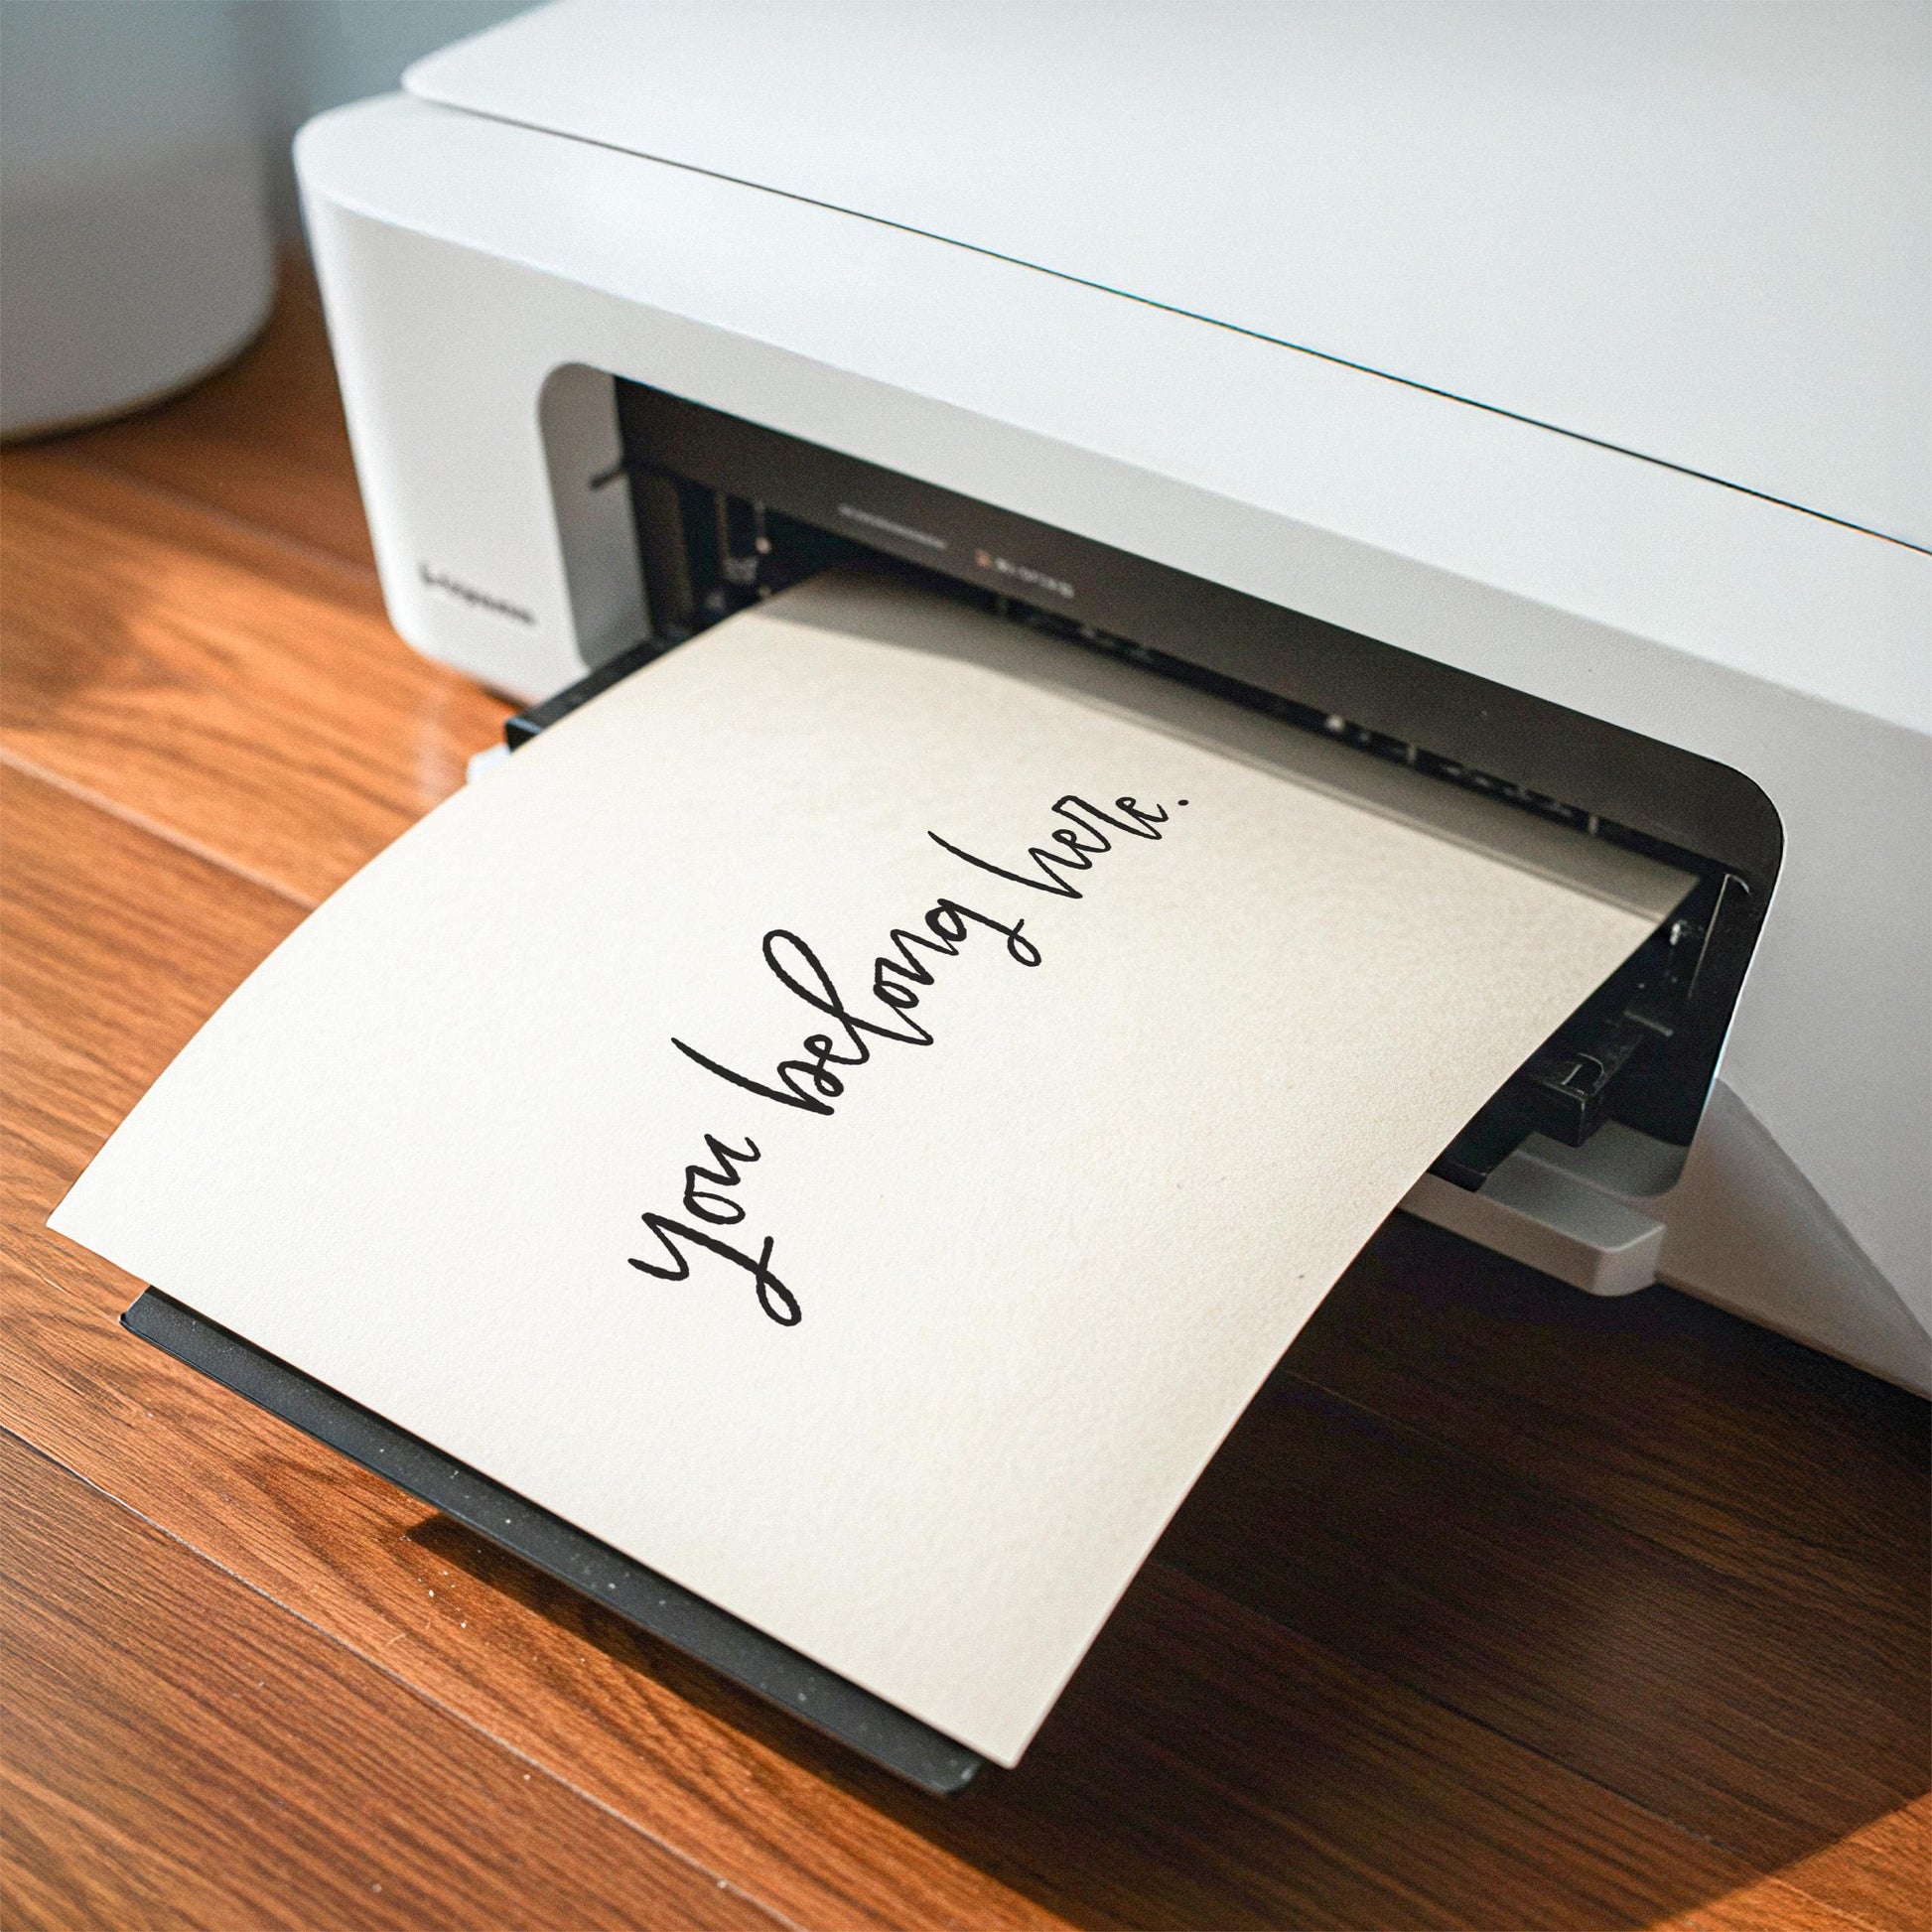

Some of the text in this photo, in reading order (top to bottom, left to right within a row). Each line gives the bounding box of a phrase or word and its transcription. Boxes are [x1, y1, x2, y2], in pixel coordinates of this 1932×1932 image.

[627, 794, 1190, 1327] you belong here.
